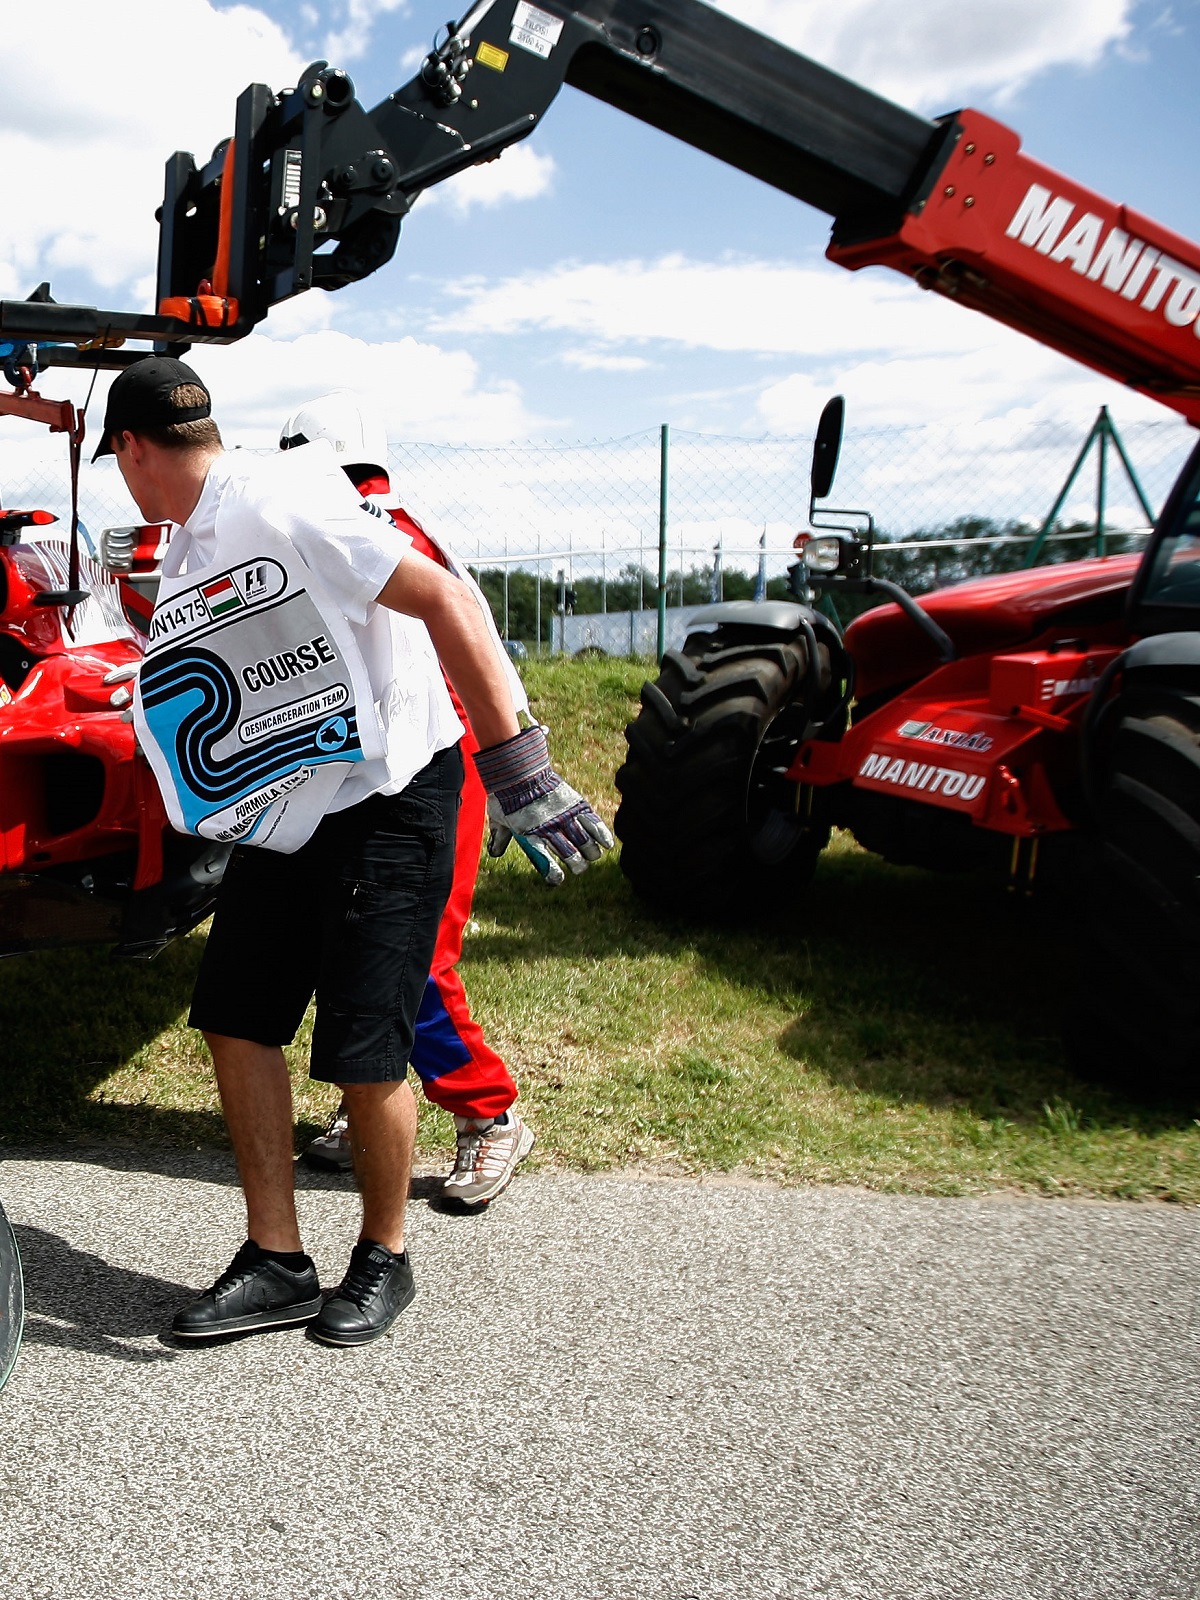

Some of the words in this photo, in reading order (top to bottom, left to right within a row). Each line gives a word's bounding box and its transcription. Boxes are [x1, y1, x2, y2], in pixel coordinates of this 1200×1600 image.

[1004, 182, 1200, 341] MANITO
[241, 634, 337, 693] COURSE
[244, 698, 321, 738] DESINCARCERATION
[321, 689, 345, 708] TEAM
[918, 727, 994, 753] AXIÁL
[859, 753, 987, 801] MANITOU
[234, 788, 281, 821] FORMULA
[215, 830, 234, 842] ING
